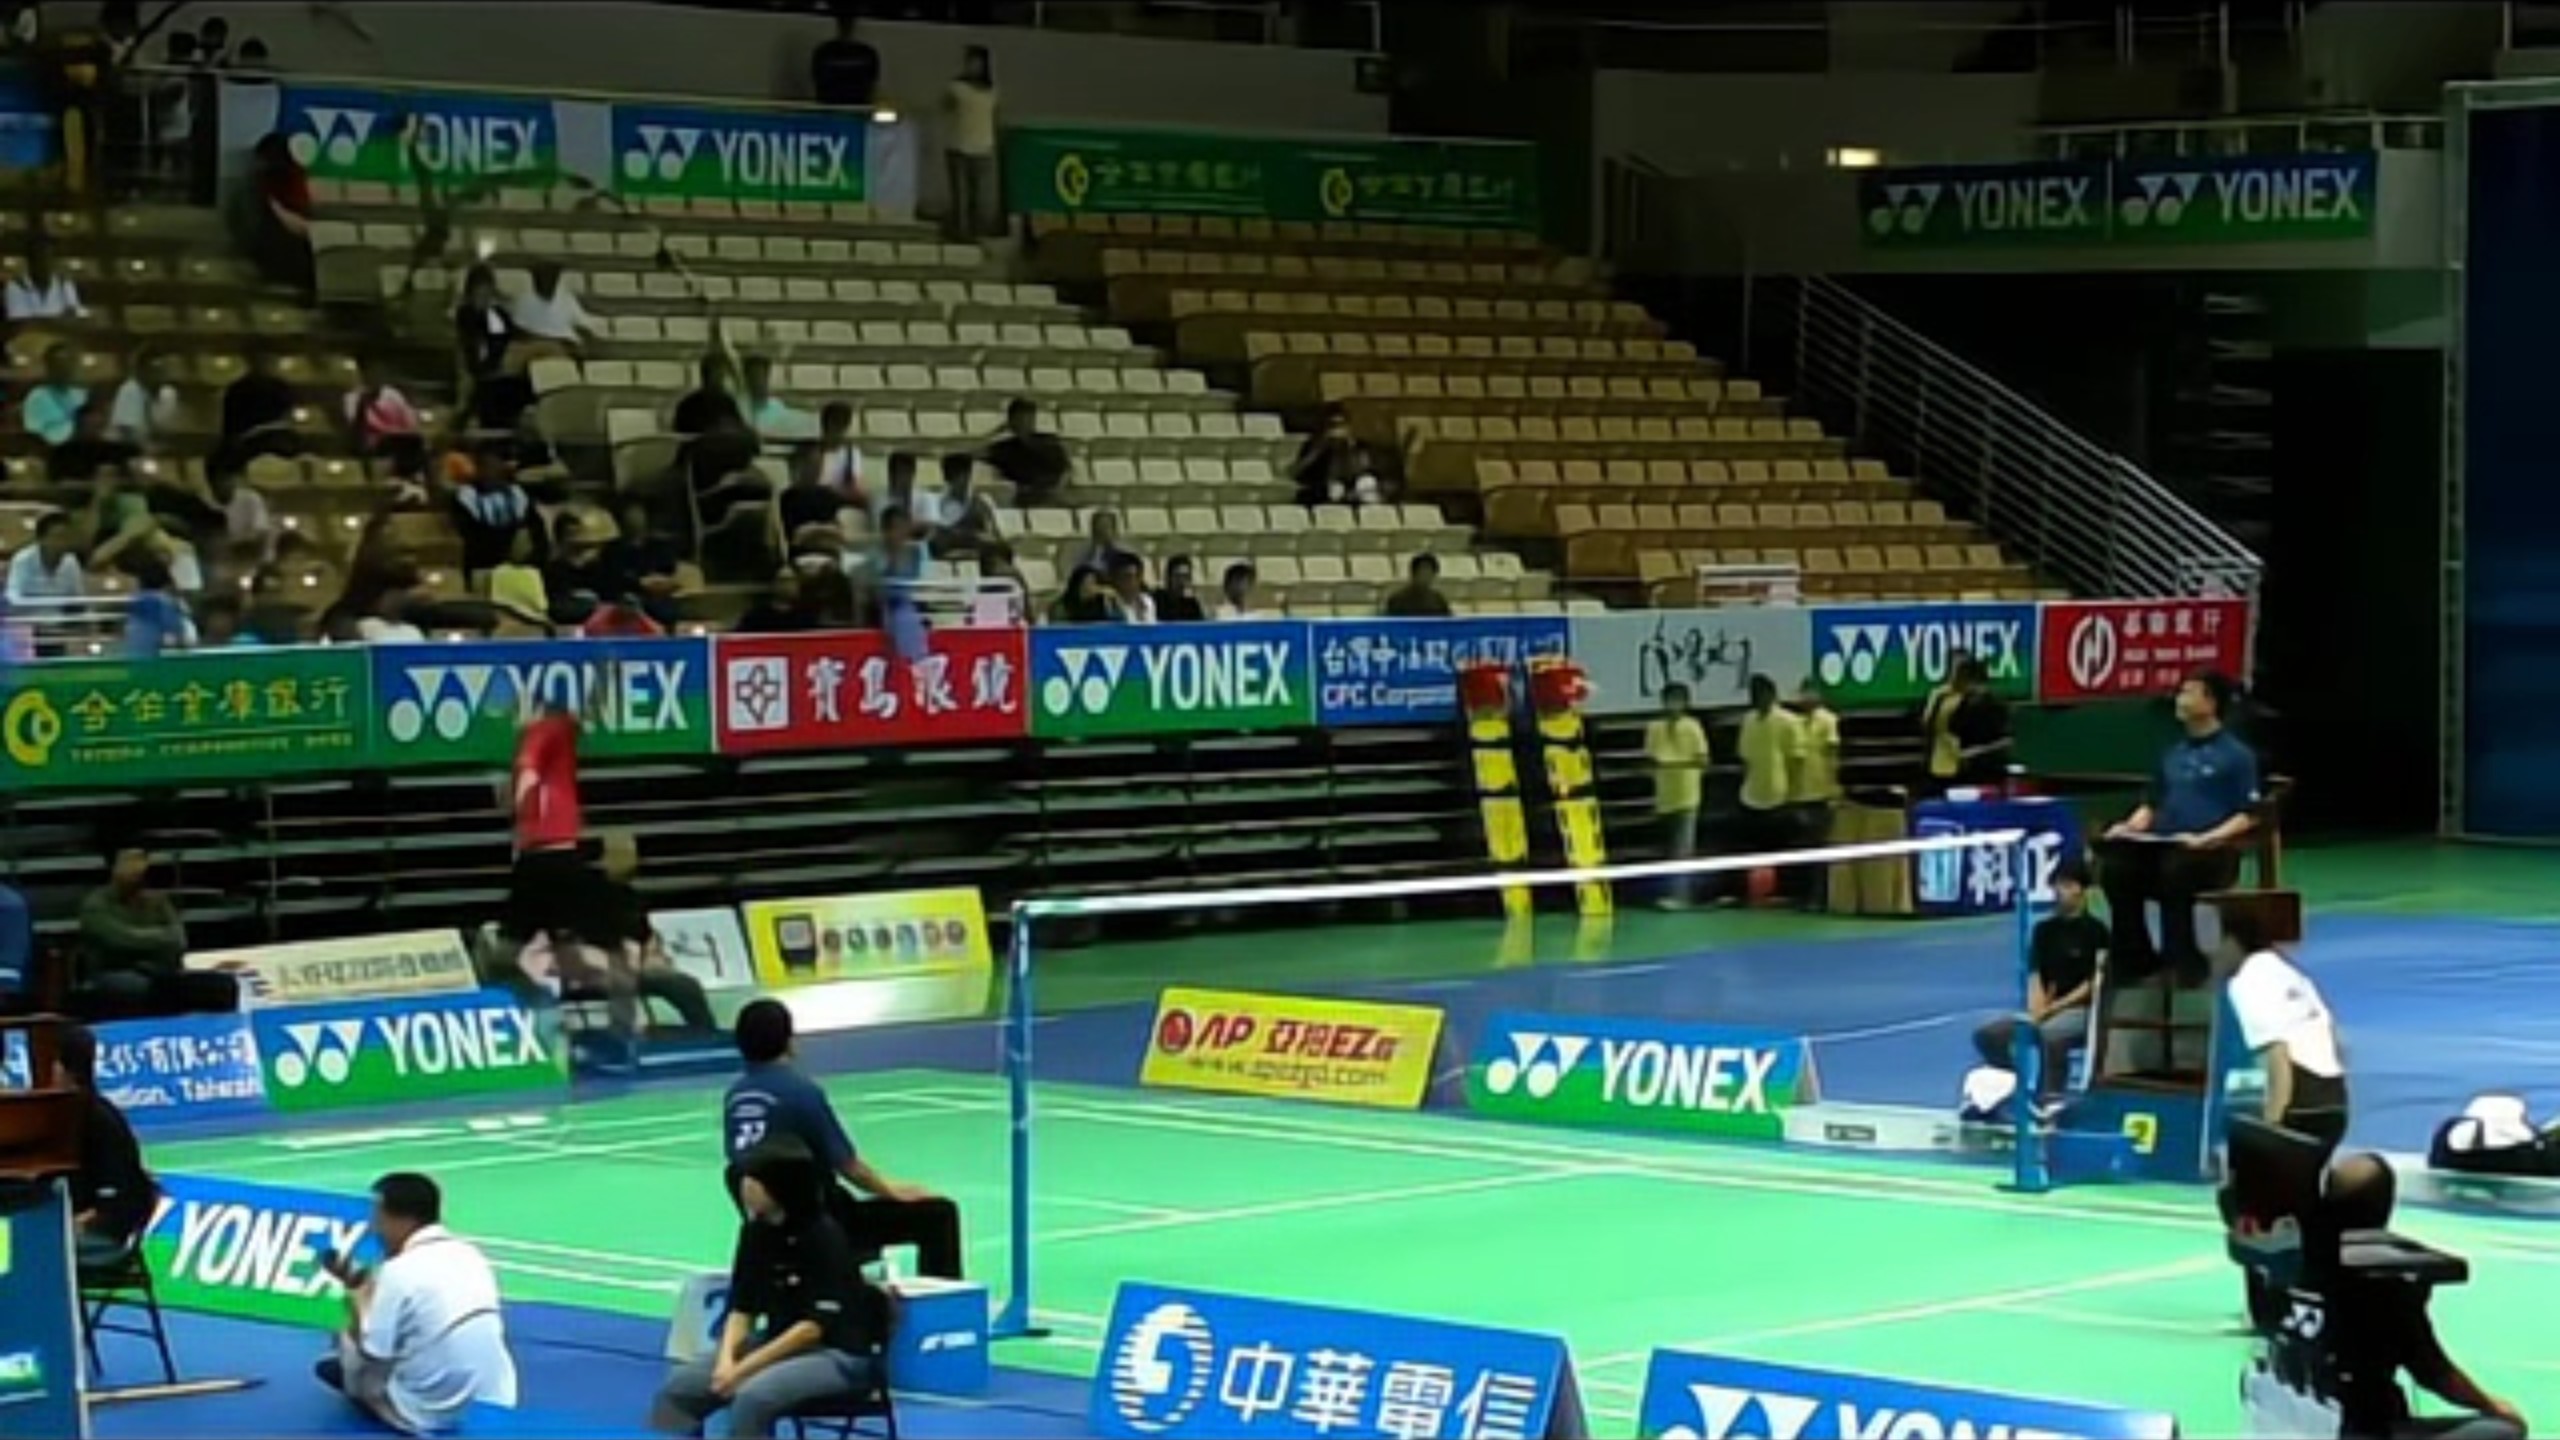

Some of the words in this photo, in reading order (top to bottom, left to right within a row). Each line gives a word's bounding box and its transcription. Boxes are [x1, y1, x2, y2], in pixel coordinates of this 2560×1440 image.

[713, 130, 852, 188] YONEX
[1954, 175, 2092, 232] YONEX
[2213, 167, 2360, 222] YONEX
[509, 658, 690, 732] YONEX
[1141, 640, 1293, 710] YONEX
[375, 1007, 550, 1077] YONEX
[1601, 1036, 1777, 1115] YONEX
[171, 1198, 369, 1298] YONEX
[1218, 1339, 1539, 1440] 中華電信
